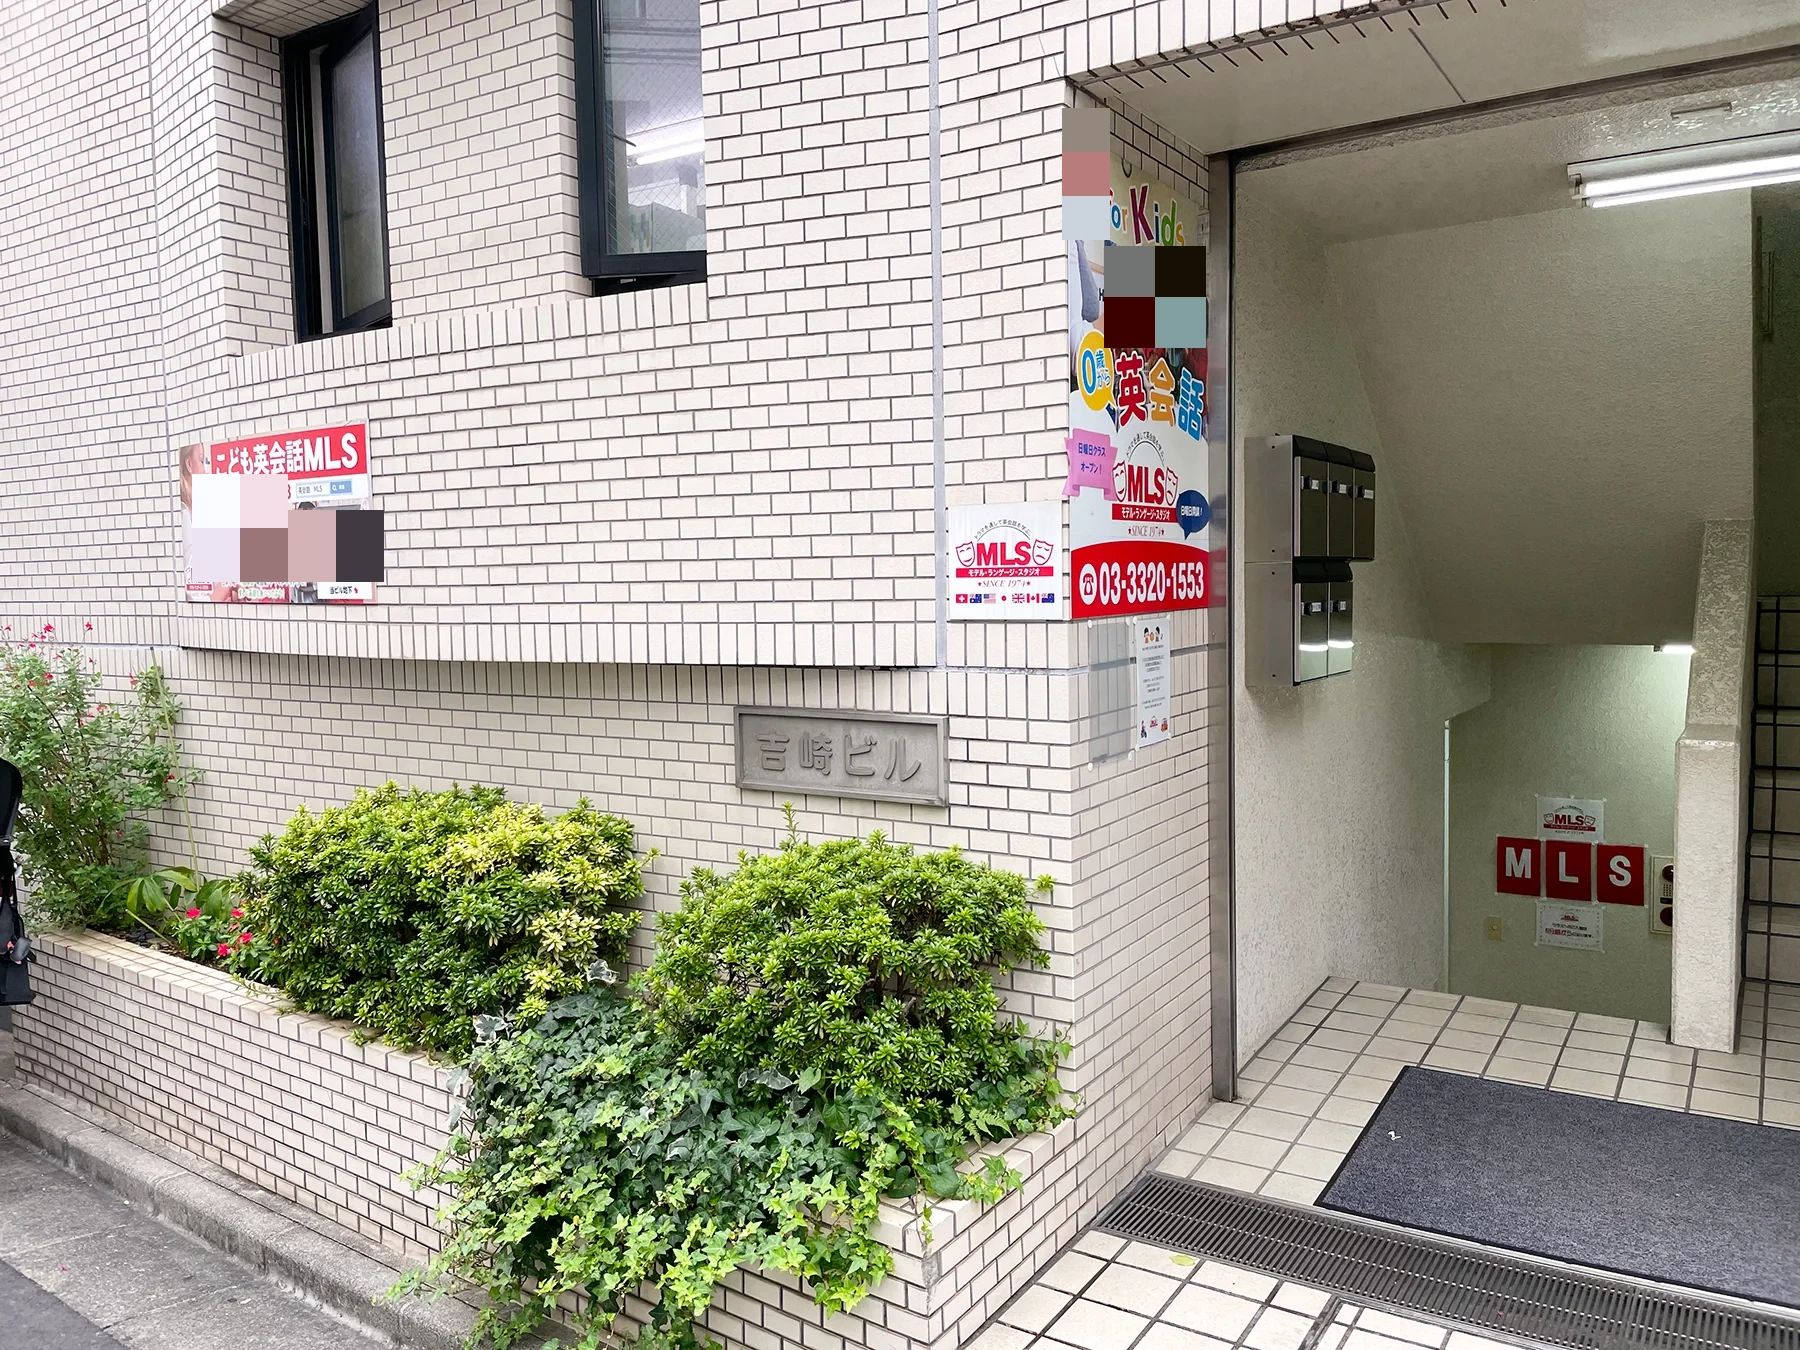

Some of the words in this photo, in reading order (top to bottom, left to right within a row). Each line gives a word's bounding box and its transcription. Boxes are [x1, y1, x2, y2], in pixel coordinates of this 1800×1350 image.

[1130, 185, 1184, 246] Kids
[1116, 352, 1204, 441] 英会話
[1078, 443, 1106, 457] 日曜日クラス
[1127, 464, 1165, 505] MLS
[1131, 525, 1148, 536] SINCE
[976, 541, 1032, 566] MLS
[968, 568, 1040, 577] モデル・ランゲージ・スタジオ
[983, 580, 1005, 588] SINCE
[1100, 561, 1204, 605] 03-3320-1553
[756, 731, 922, 782] 吉崎ビル
[1555, 814, 1585, 826] MLS
